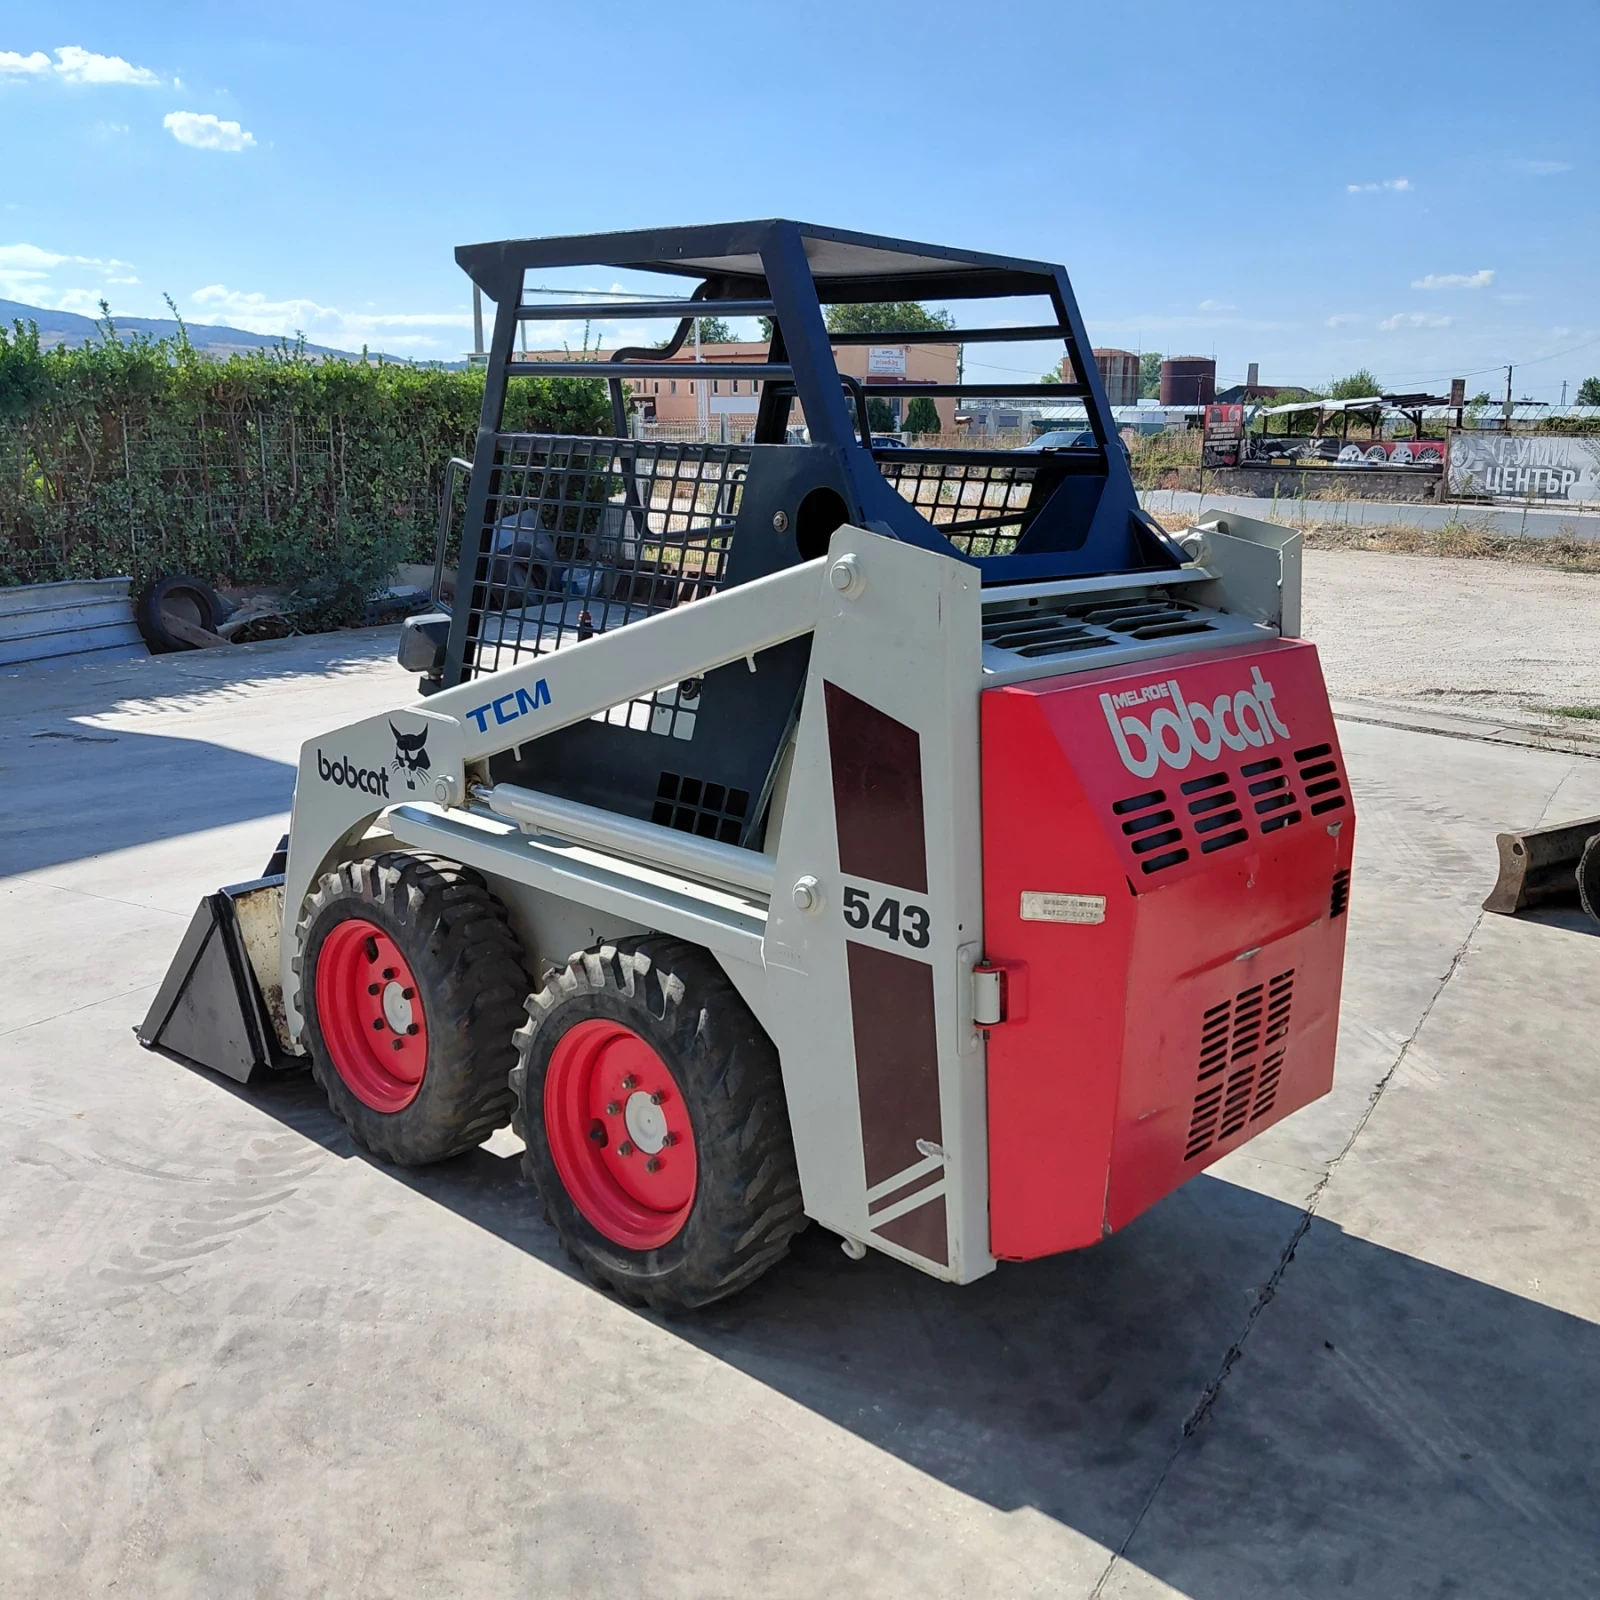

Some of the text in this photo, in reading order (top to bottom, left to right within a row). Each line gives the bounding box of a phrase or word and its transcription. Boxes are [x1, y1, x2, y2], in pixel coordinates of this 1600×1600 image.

[1498, 438, 1570, 467] ГУМИ
[1485, 466, 1576, 494] ЦЕНТЪР
[465, 678, 552, 733] TCM
[1111, 682, 1170, 710] MELROE
[1099, 665, 1291, 779] bobcat
[317, 748, 390, 799] bobcat
[843, 885, 931, 949] 543
